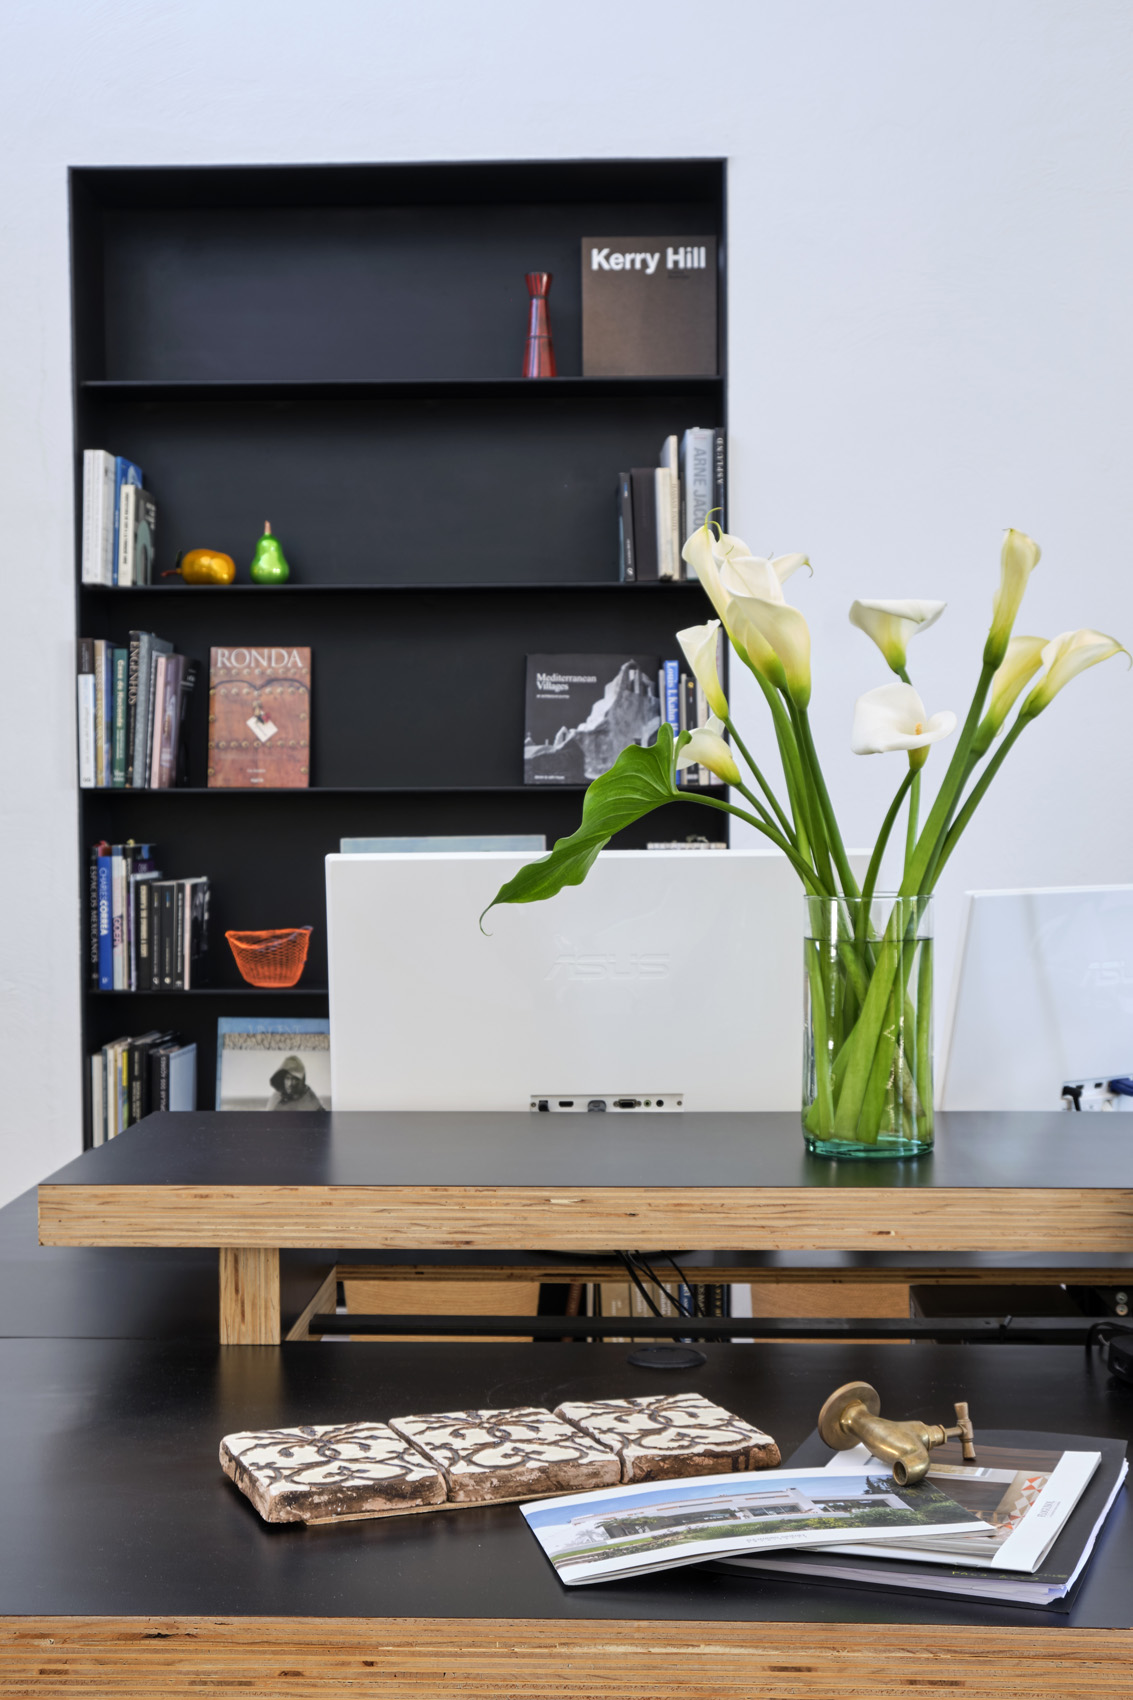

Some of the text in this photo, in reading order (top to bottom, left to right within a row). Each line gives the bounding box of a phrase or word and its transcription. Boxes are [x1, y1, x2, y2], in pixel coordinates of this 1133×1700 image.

[591, 246, 706, 275] Kerry Hill
[716, 437, 724, 485] ASPLUND
[692, 447, 708, 531] ARNE JACO
[216, 648, 303, 668] RONDA
[128, 641, 139, 705] ENGENHOS
[536, 672, 597, 683] Mediterranean
[536, 681, 569, 692] Villages
[666, 661, 678, 688] Louis
[667, 697, 679, 721] Kahn
[89, 865, 99, 963] ESPACIOS MEXICANOS
[99, 900, 109, 936] CORREA
[543, 952, 672, 982] ASUS
